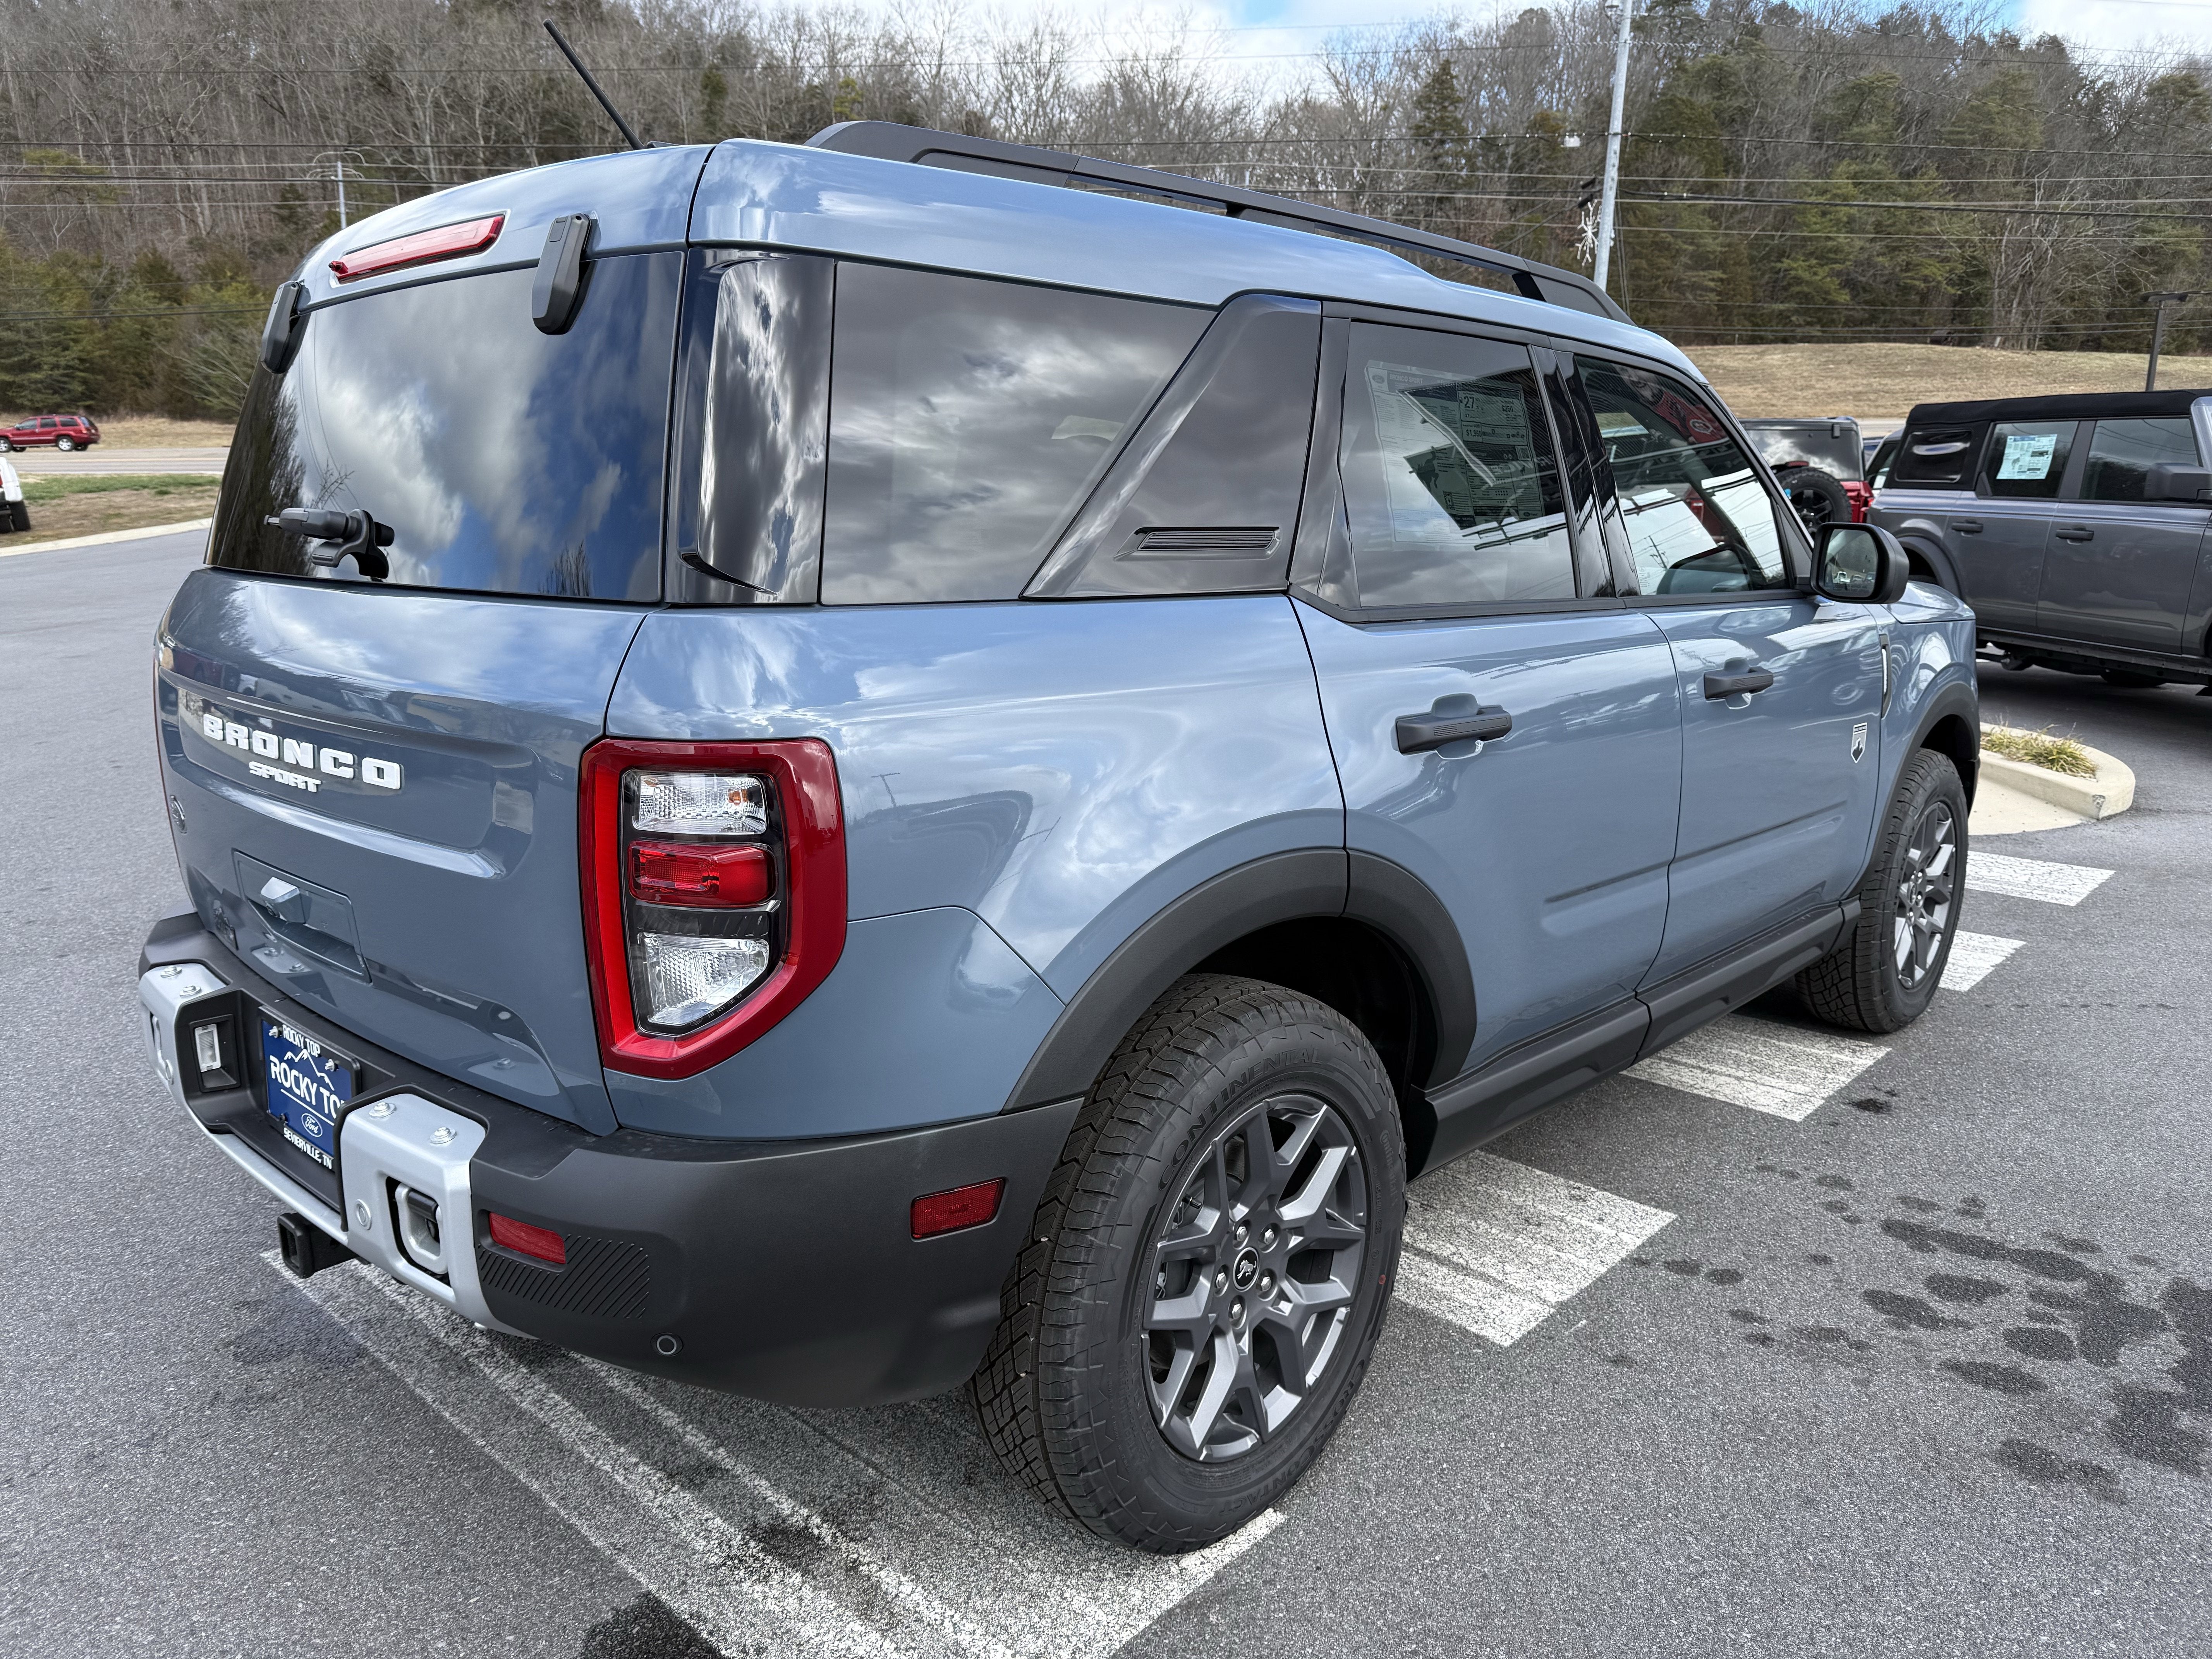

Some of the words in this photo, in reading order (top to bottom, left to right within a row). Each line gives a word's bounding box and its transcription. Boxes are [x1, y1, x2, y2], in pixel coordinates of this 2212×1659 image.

[1464, 396, 1474, 409] 27
[203, 714, 401, 790] BRONCO
[249, 761, 321, 792] SPORT
[282, 1024, 304, 1049] ROCKY
[305, 1038, 321, 1057] TOP
[270, 1055, 317, 1106] ROCKY
[319, 1087, 345, 1119] TO
[305, 1116, 319, 1134] Ford
[1158, 1047, 1324, 1191] CONTINENTAL
[283, 1127, 322, 1163] SEVIERVILLE,
[322, 1154, 332, 1170] TN
